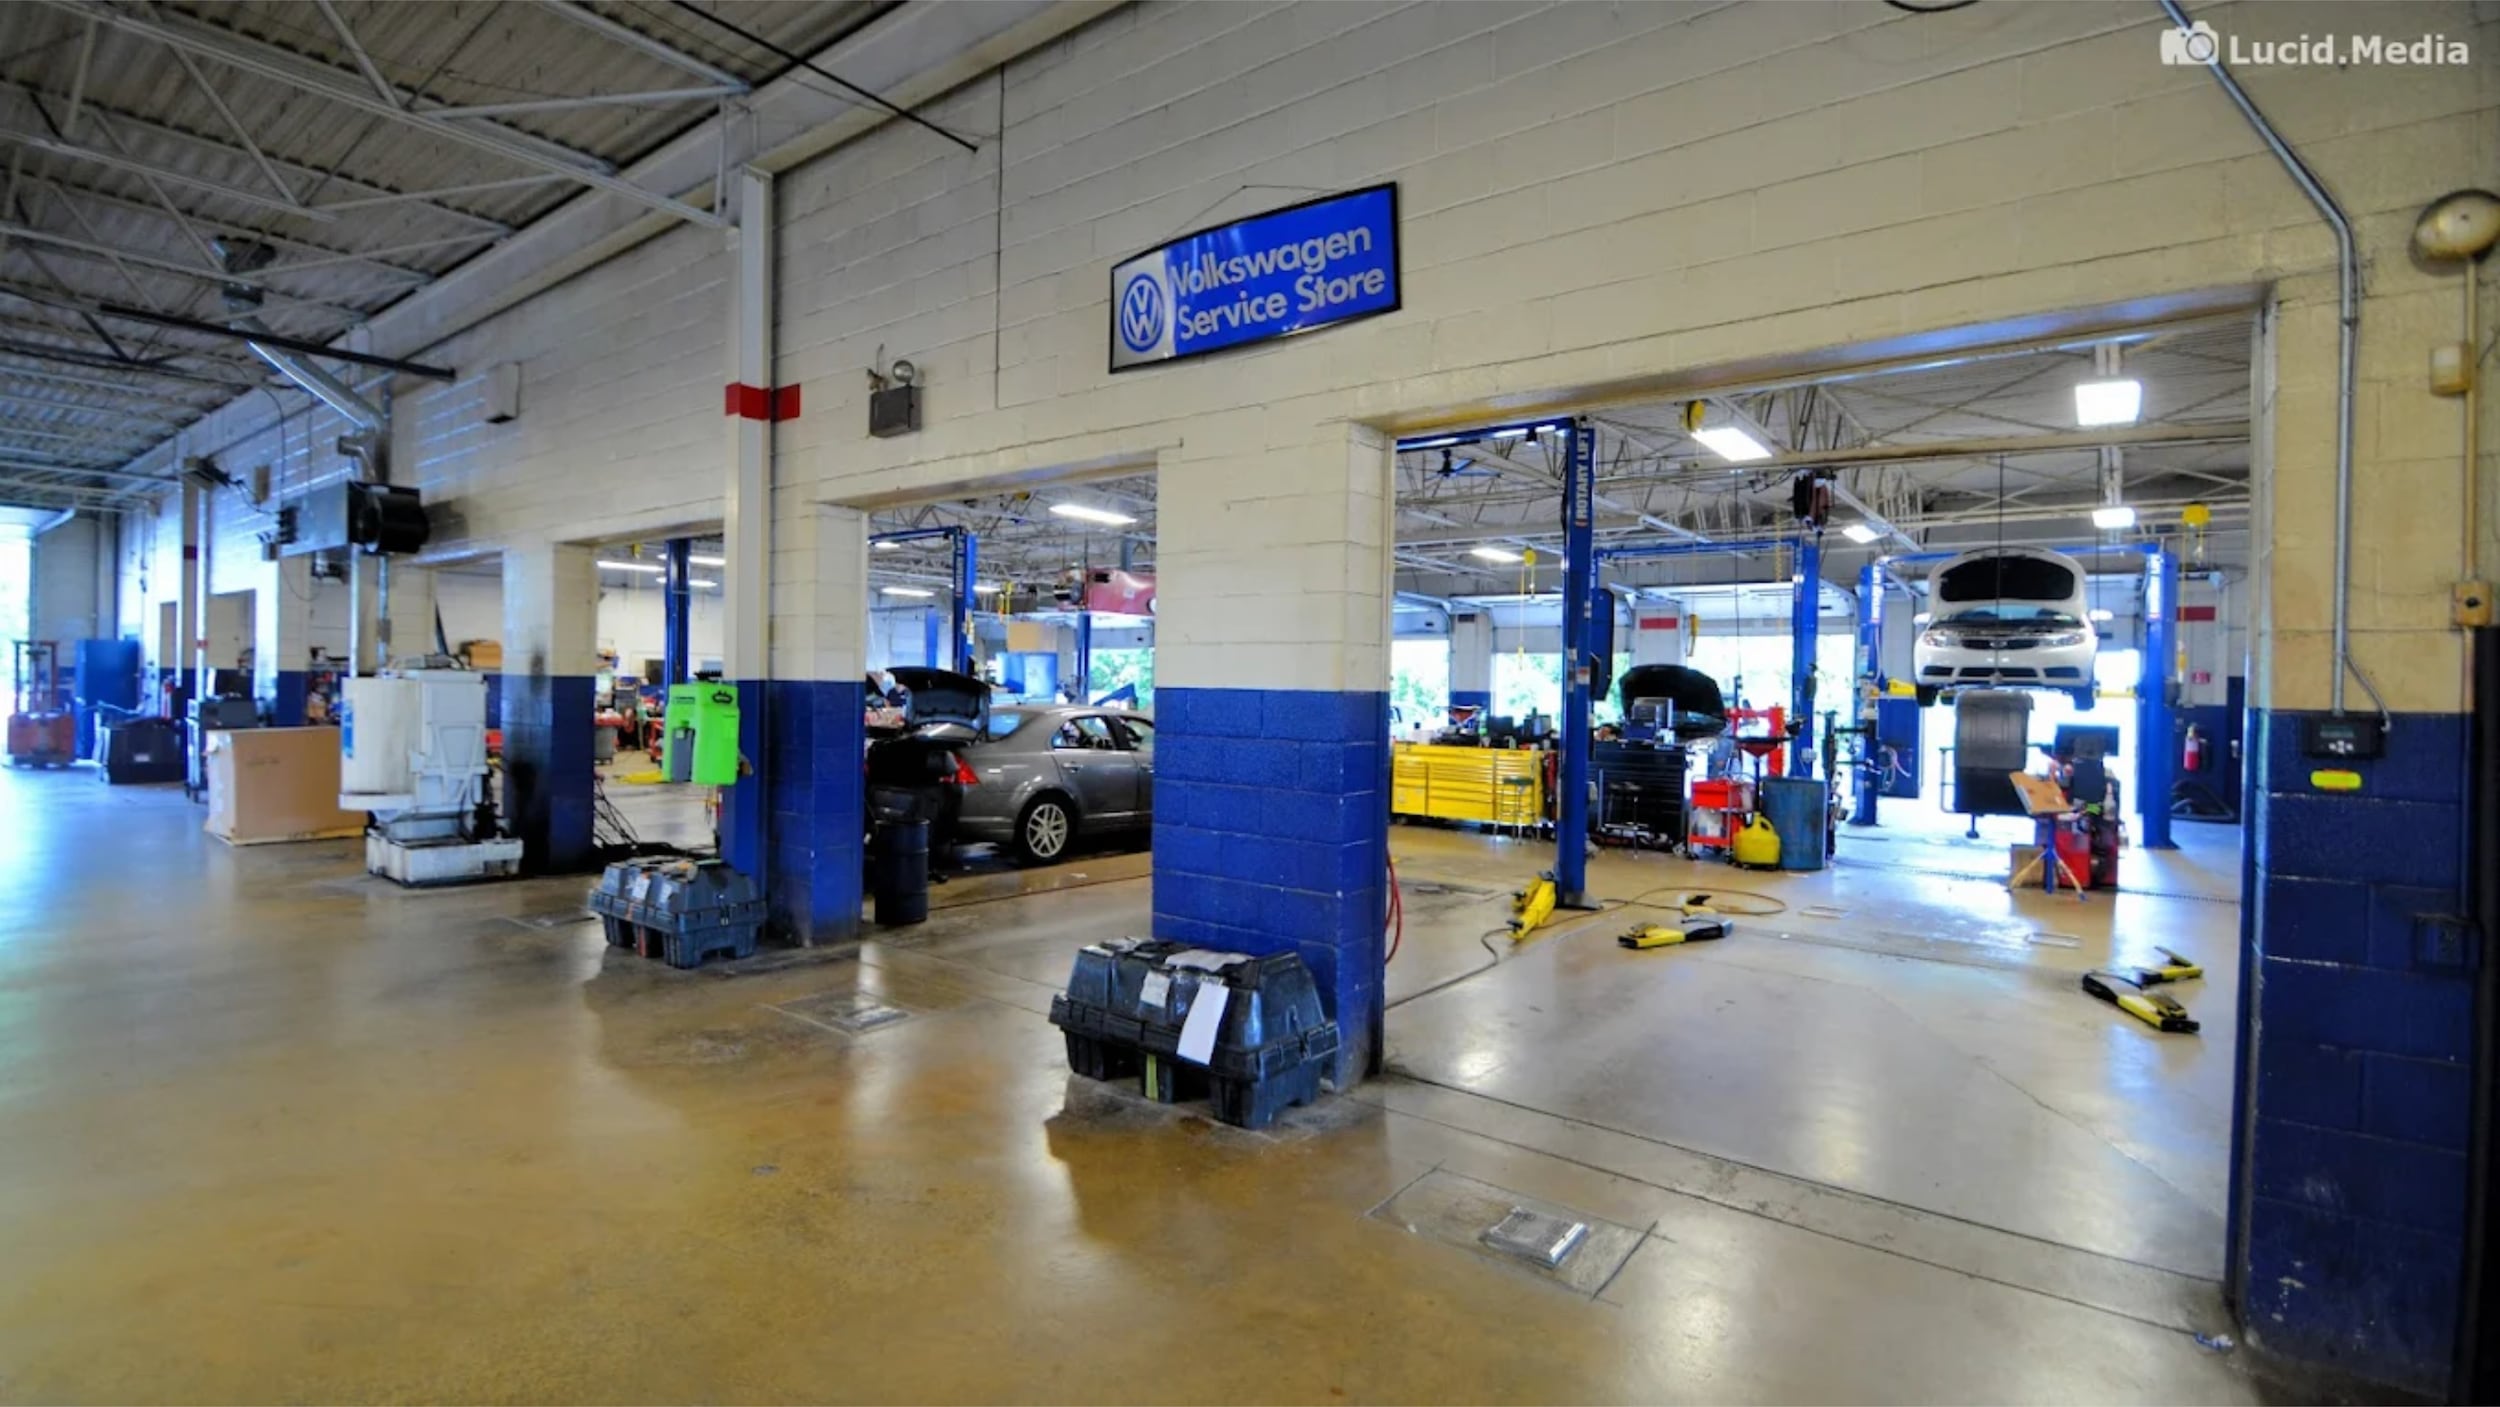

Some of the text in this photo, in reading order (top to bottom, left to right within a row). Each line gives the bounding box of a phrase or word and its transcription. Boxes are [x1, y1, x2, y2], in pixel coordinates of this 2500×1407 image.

[1170, 226, 1372, 297] Volkswagen
[1176, 268, 1385, 340] Service Store
[1575, 430, 1589, 519] ROTARY LIFT
